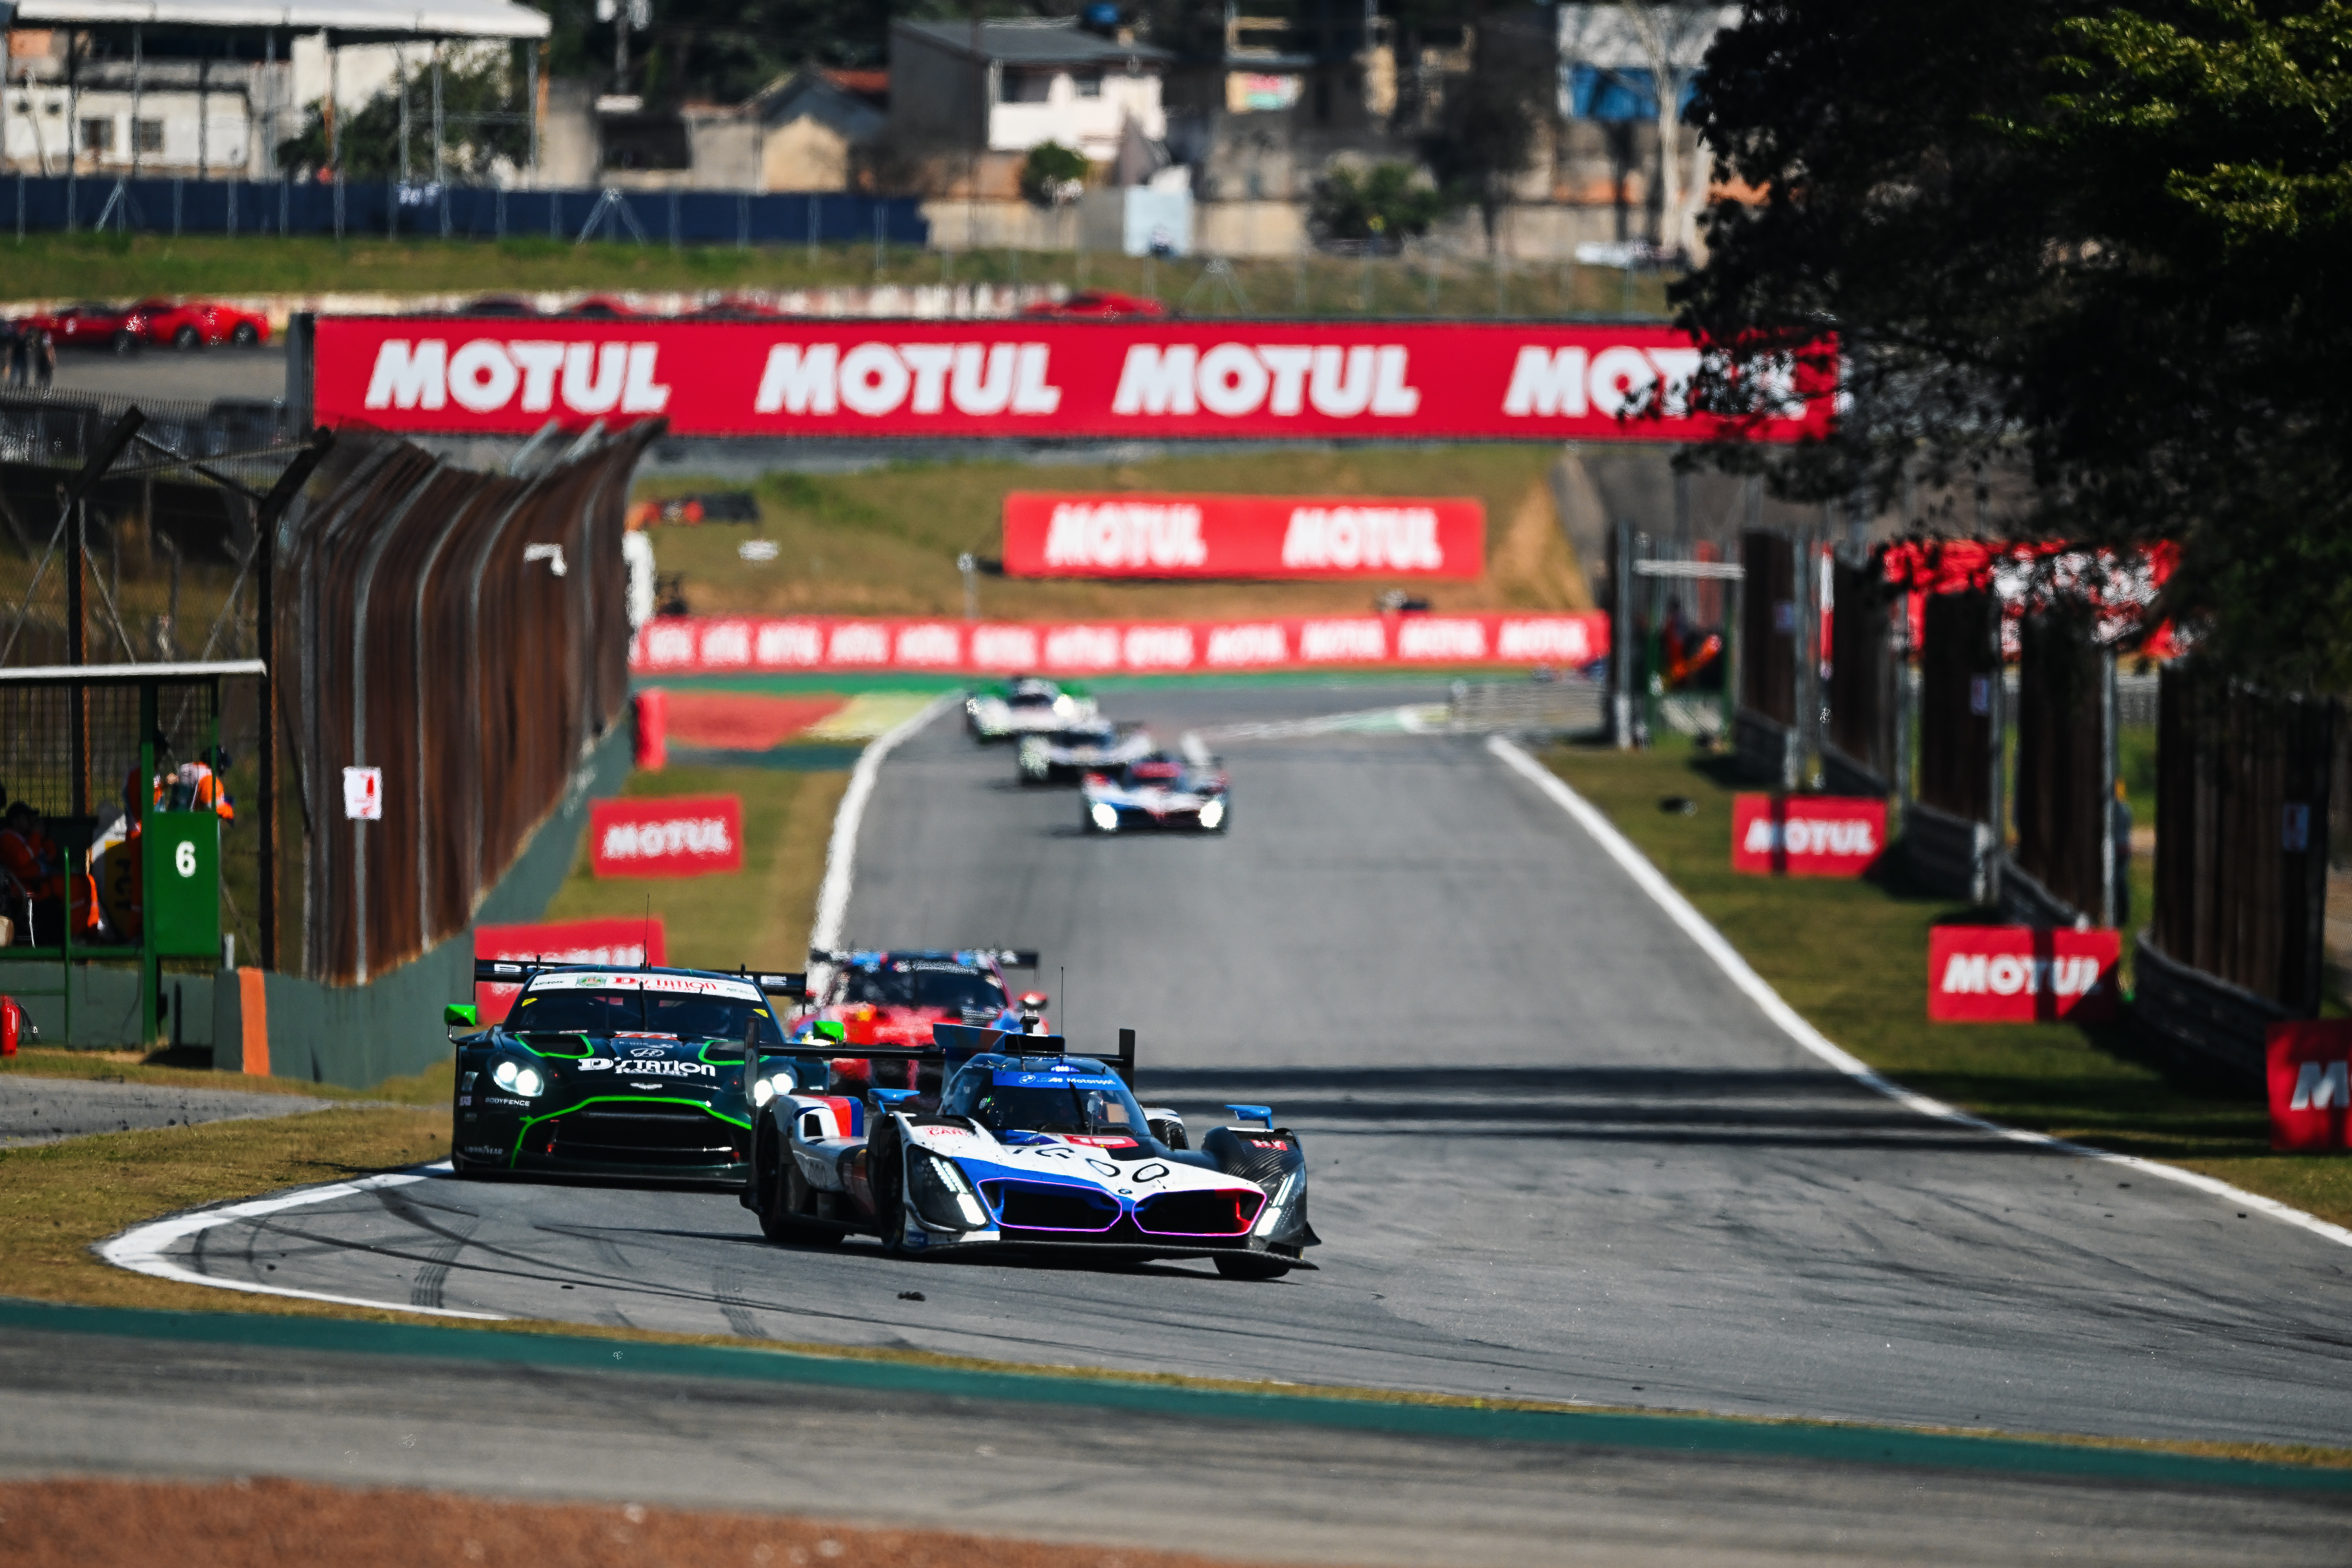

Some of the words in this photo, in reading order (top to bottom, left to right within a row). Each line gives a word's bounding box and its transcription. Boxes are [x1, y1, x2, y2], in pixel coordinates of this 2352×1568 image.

[365, 339, 671, 413] MOTUL
[755, 342, 1062, 415] MOTUL
[1112, 342, 1421, 417] MOTUL
[1045, 501, 1208, 568] MOTUL
[1282, 506, 1445, 570] MOTUL
[602, 817, 732, 860] MOTUL
[1744, 817, 1878, 855] MOTUL
[176, 841, 196, 878] 6
[1941, 953, 2103, 996] MOTUL
[1066, 1077, 1116, 1085] Motorsport
